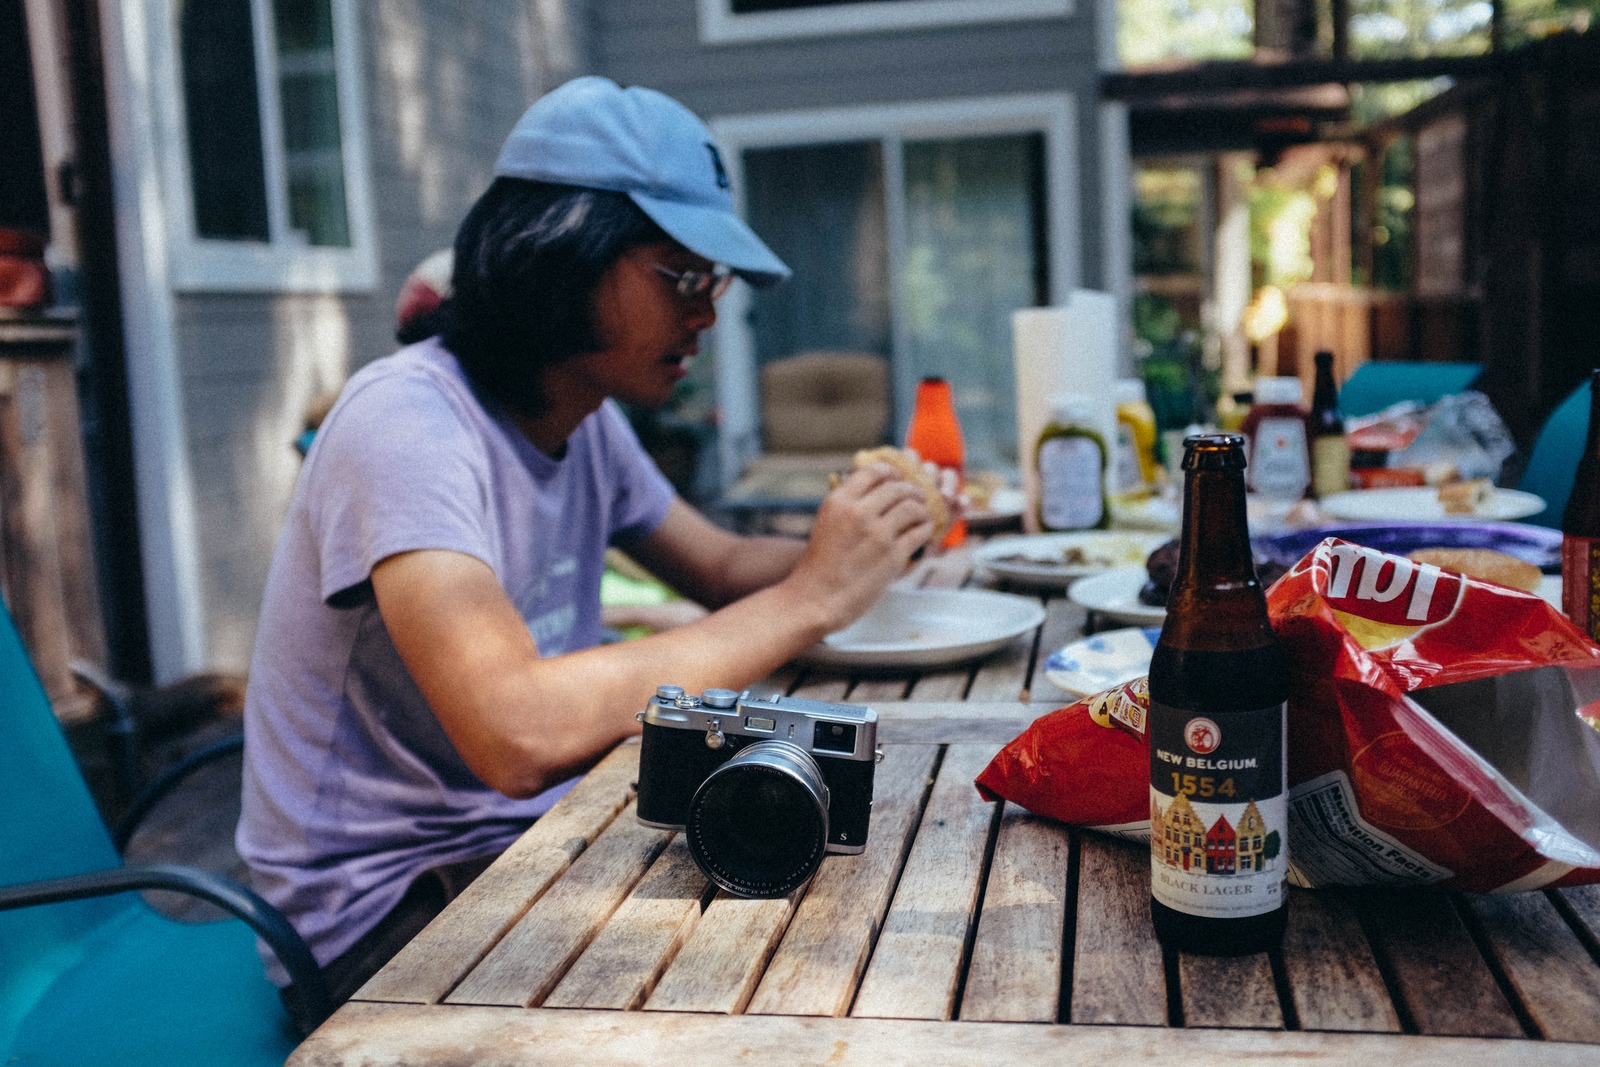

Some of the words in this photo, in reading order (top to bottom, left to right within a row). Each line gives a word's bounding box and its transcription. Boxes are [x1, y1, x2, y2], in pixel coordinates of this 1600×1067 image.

[1156, 749, 1183, 765] NEW
[1186, 757, 1257, 770] BELGIUM
[1171, 772, 1237, 797] 1554
[840, 833, 848, 841] S
[1330, 786, 1385, 852] Nutrition
[1385, 849, 1432, 878] Facts
[1161, 873, 1198, 893] BLACK
[1203, 884, 1253, 896] LAGER
